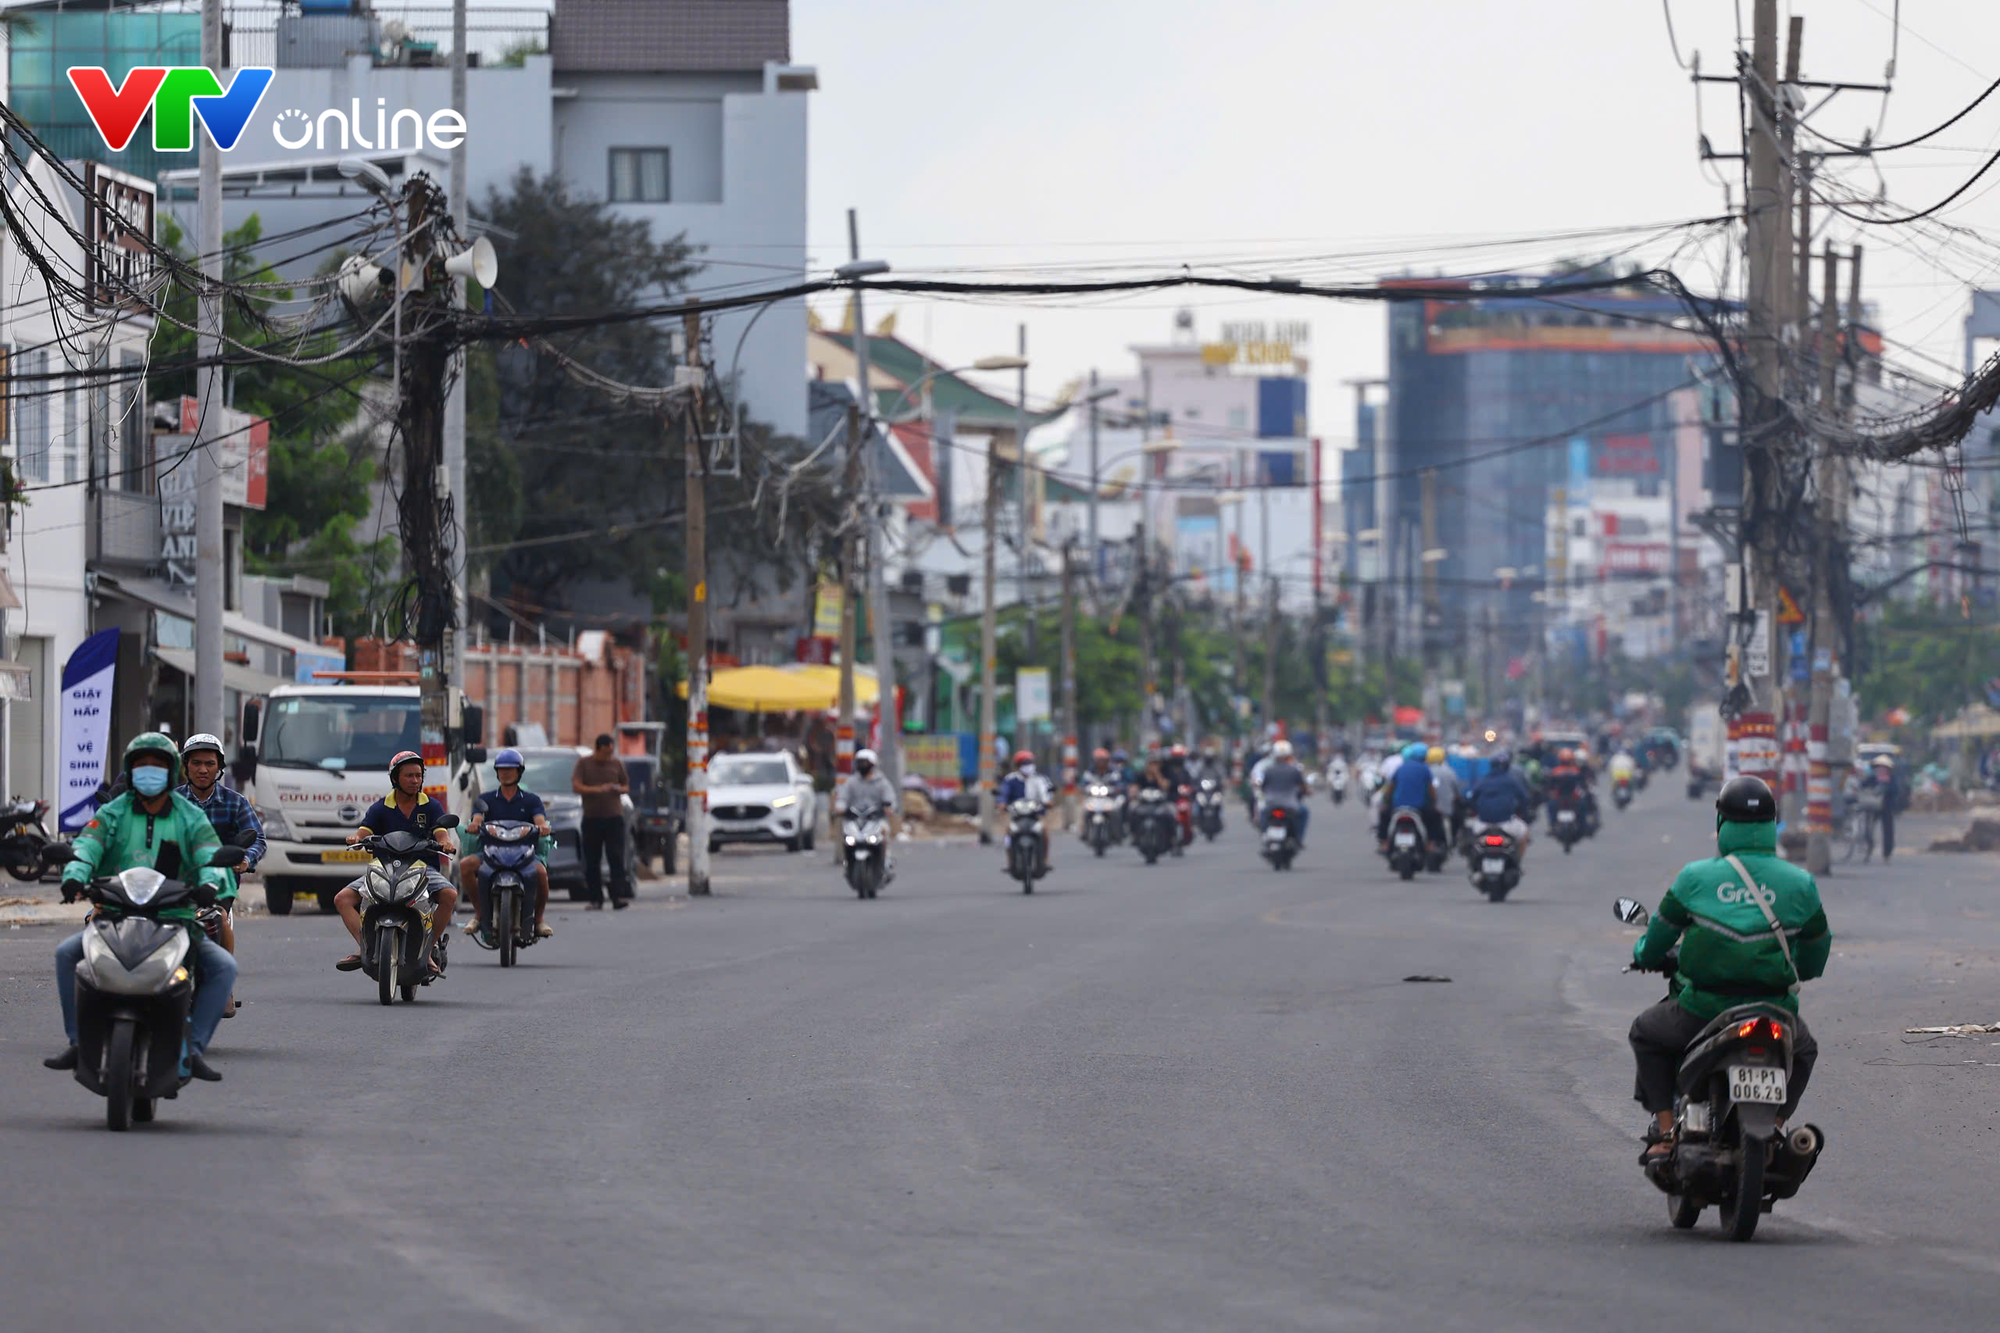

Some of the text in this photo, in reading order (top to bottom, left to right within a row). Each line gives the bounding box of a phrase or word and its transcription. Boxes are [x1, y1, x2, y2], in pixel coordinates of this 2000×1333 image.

[69, 760, 99, 770] SINH
[361, 790, 384, 803] GÒ
[1717, 881, 1776, 906] Grab
[1738, 1068, 1776, 1085] 81-P1
[1733, 1084, 1783, 1101] 006.29
